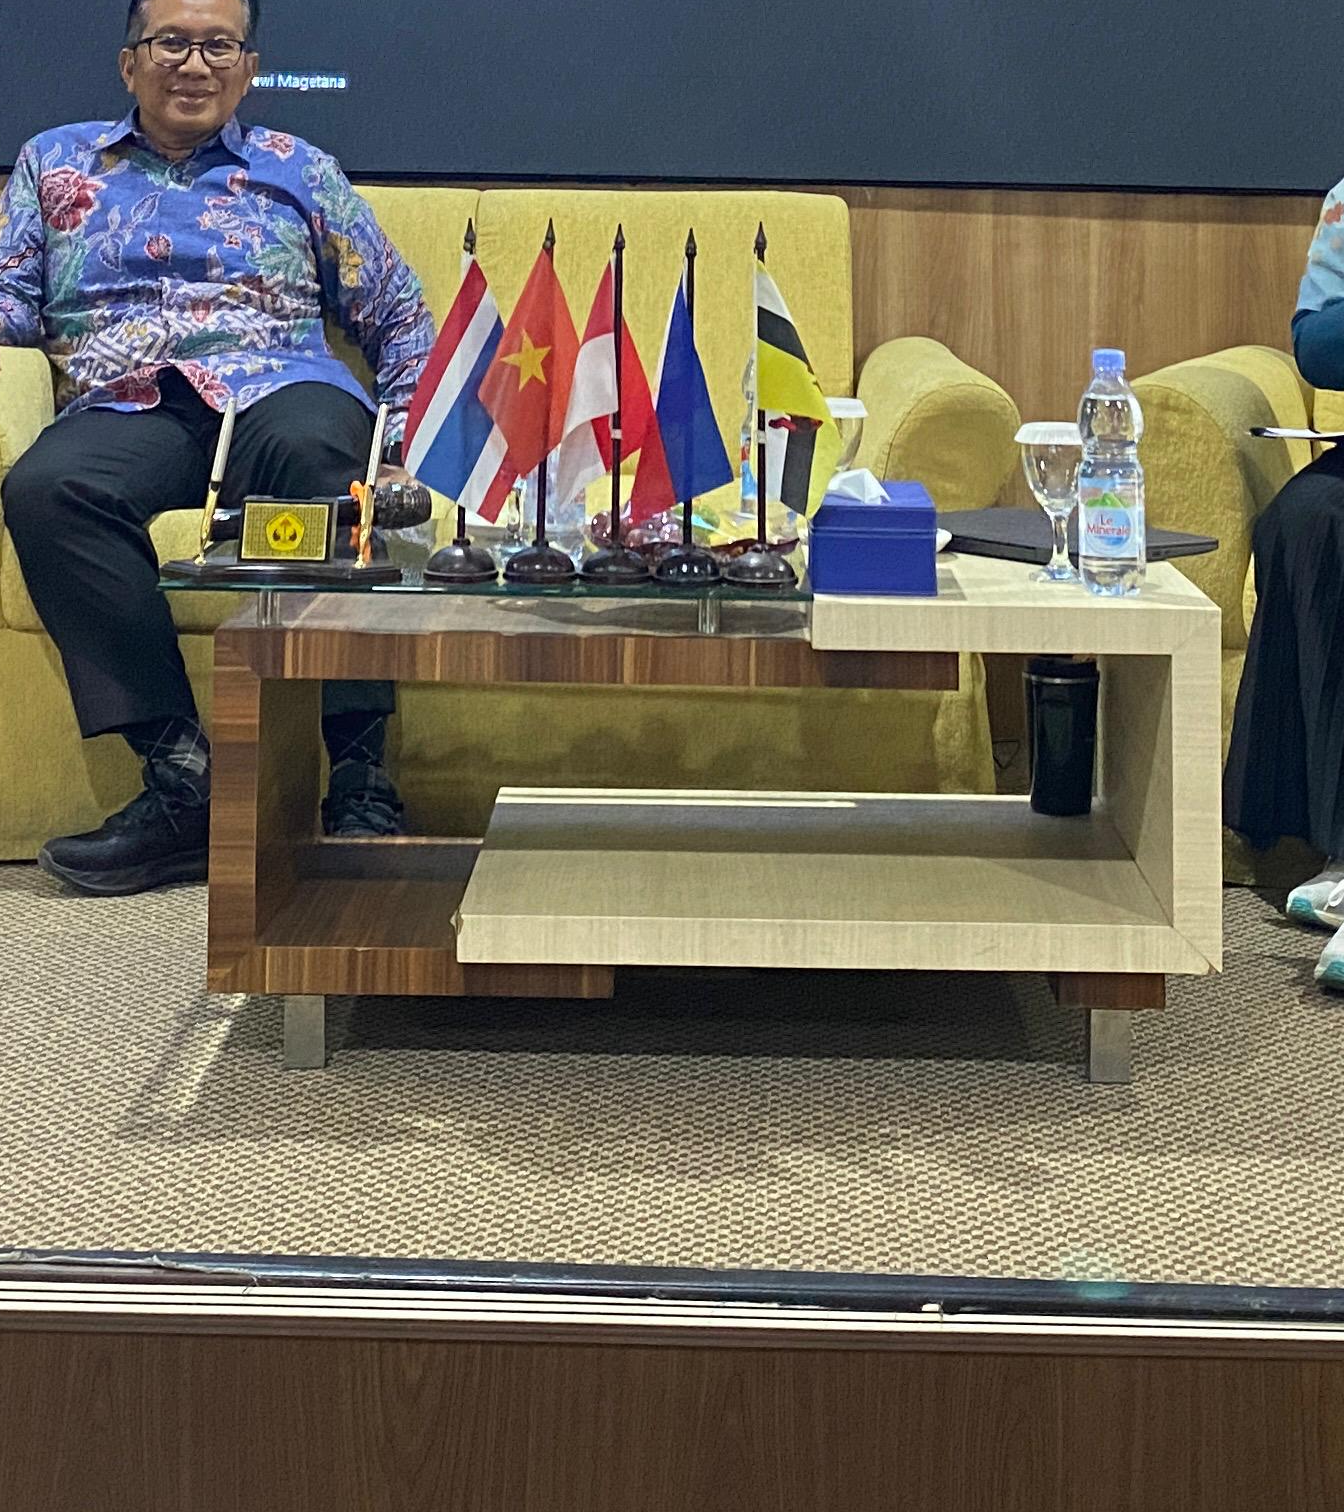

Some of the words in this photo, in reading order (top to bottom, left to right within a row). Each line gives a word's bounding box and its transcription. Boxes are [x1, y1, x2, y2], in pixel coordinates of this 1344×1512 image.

[251, 73, 275, 88] ewi
[277, 73, 346, 92] Magetana
[1100, 513, 1114, 526] Le
